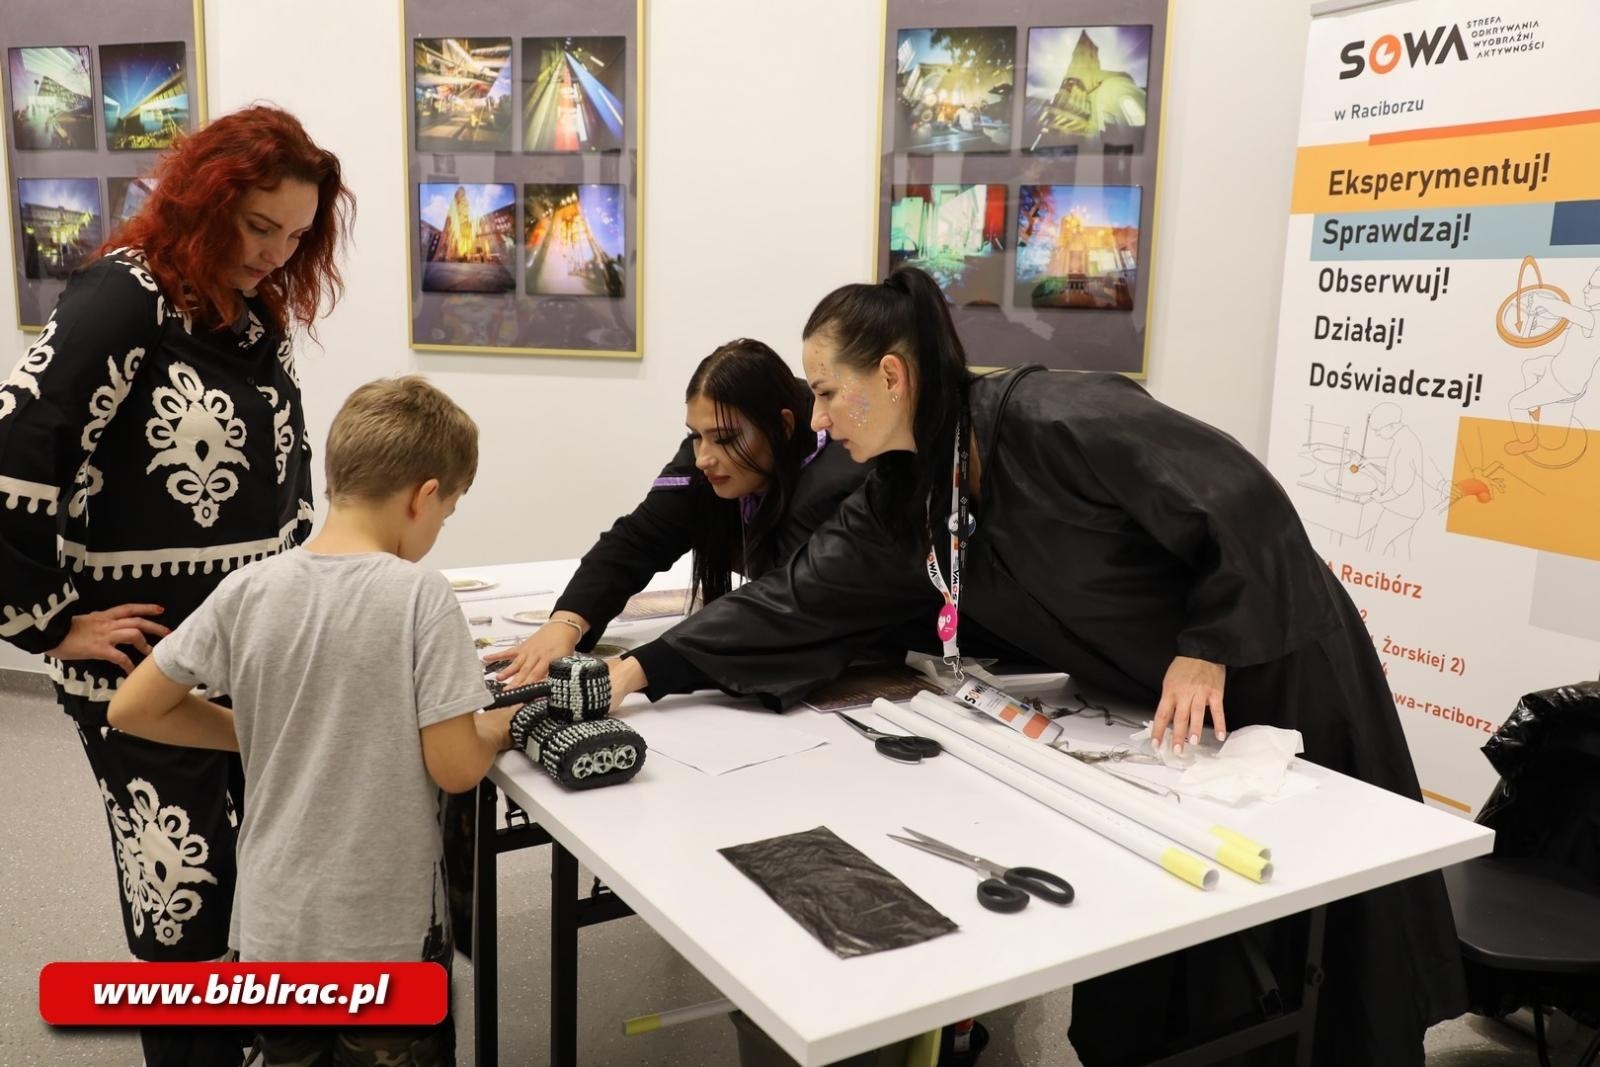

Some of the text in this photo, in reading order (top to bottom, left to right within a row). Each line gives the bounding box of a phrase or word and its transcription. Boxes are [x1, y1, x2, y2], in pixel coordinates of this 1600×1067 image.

[1466, 16, 1501, 29] STREFA
[1471, 20, 1539, 38] ODKRYWANIA
[1473, 31, 1533, 48] WYOBRAŹNI
[1339, 24, 1468, 80] SOWA
[1477, 40, 1544, 58] AKTYWNOŚCI
[1334, 97, 1424, 121] w Raciborzu
[1328, 152, 1550, 200] Eksperymentuj!
[1322, 213, 1471, 251] Sprawdzaj!
[1318, 267, 1450, 301] Obserwuj!
[1314, 315, 1404, 350] Działaj!
[1309, 362, 1483, 408] Doświadczaj!
[1341, 564, 1423, 599] Racibórz
[1382, 635, 1446, 672] Żorskiej
[1450, 657, 1466, 676] 2)
